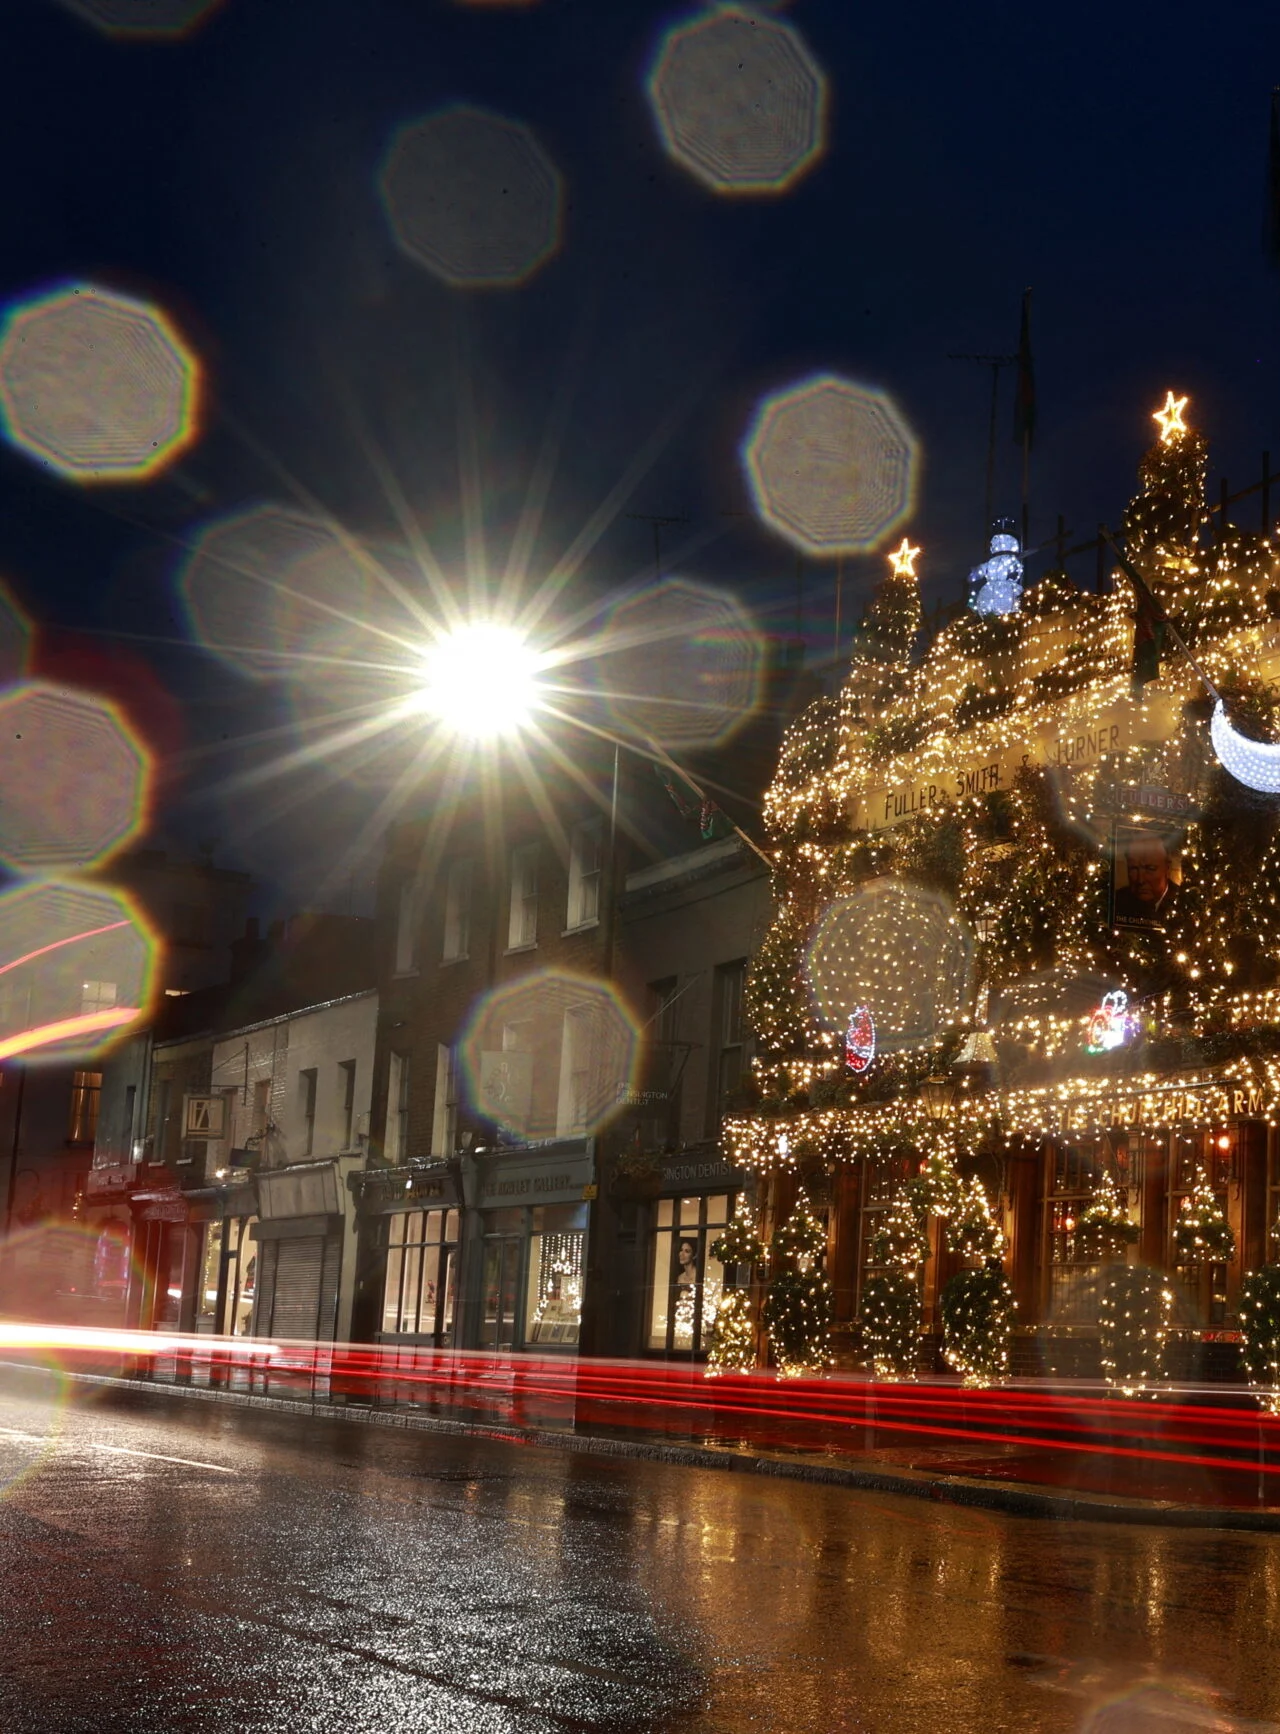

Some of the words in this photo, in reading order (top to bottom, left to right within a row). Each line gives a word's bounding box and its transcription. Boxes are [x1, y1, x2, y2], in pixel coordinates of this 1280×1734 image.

[885, 785, 937, 820] FULLER
[955, 764, 1000, 797] SMITH
[1054, 725, 1120, 764] TURNER
[1058, 1108, 1088, 1130] THE
[1098, 1095, 1204, 1127] CHURCHILL
[1216, 1088, 1265, 1115] ARM
[663, 1165, 698, 1181] SINGTON
[698, 1161, 732, 1178] DENTIST
